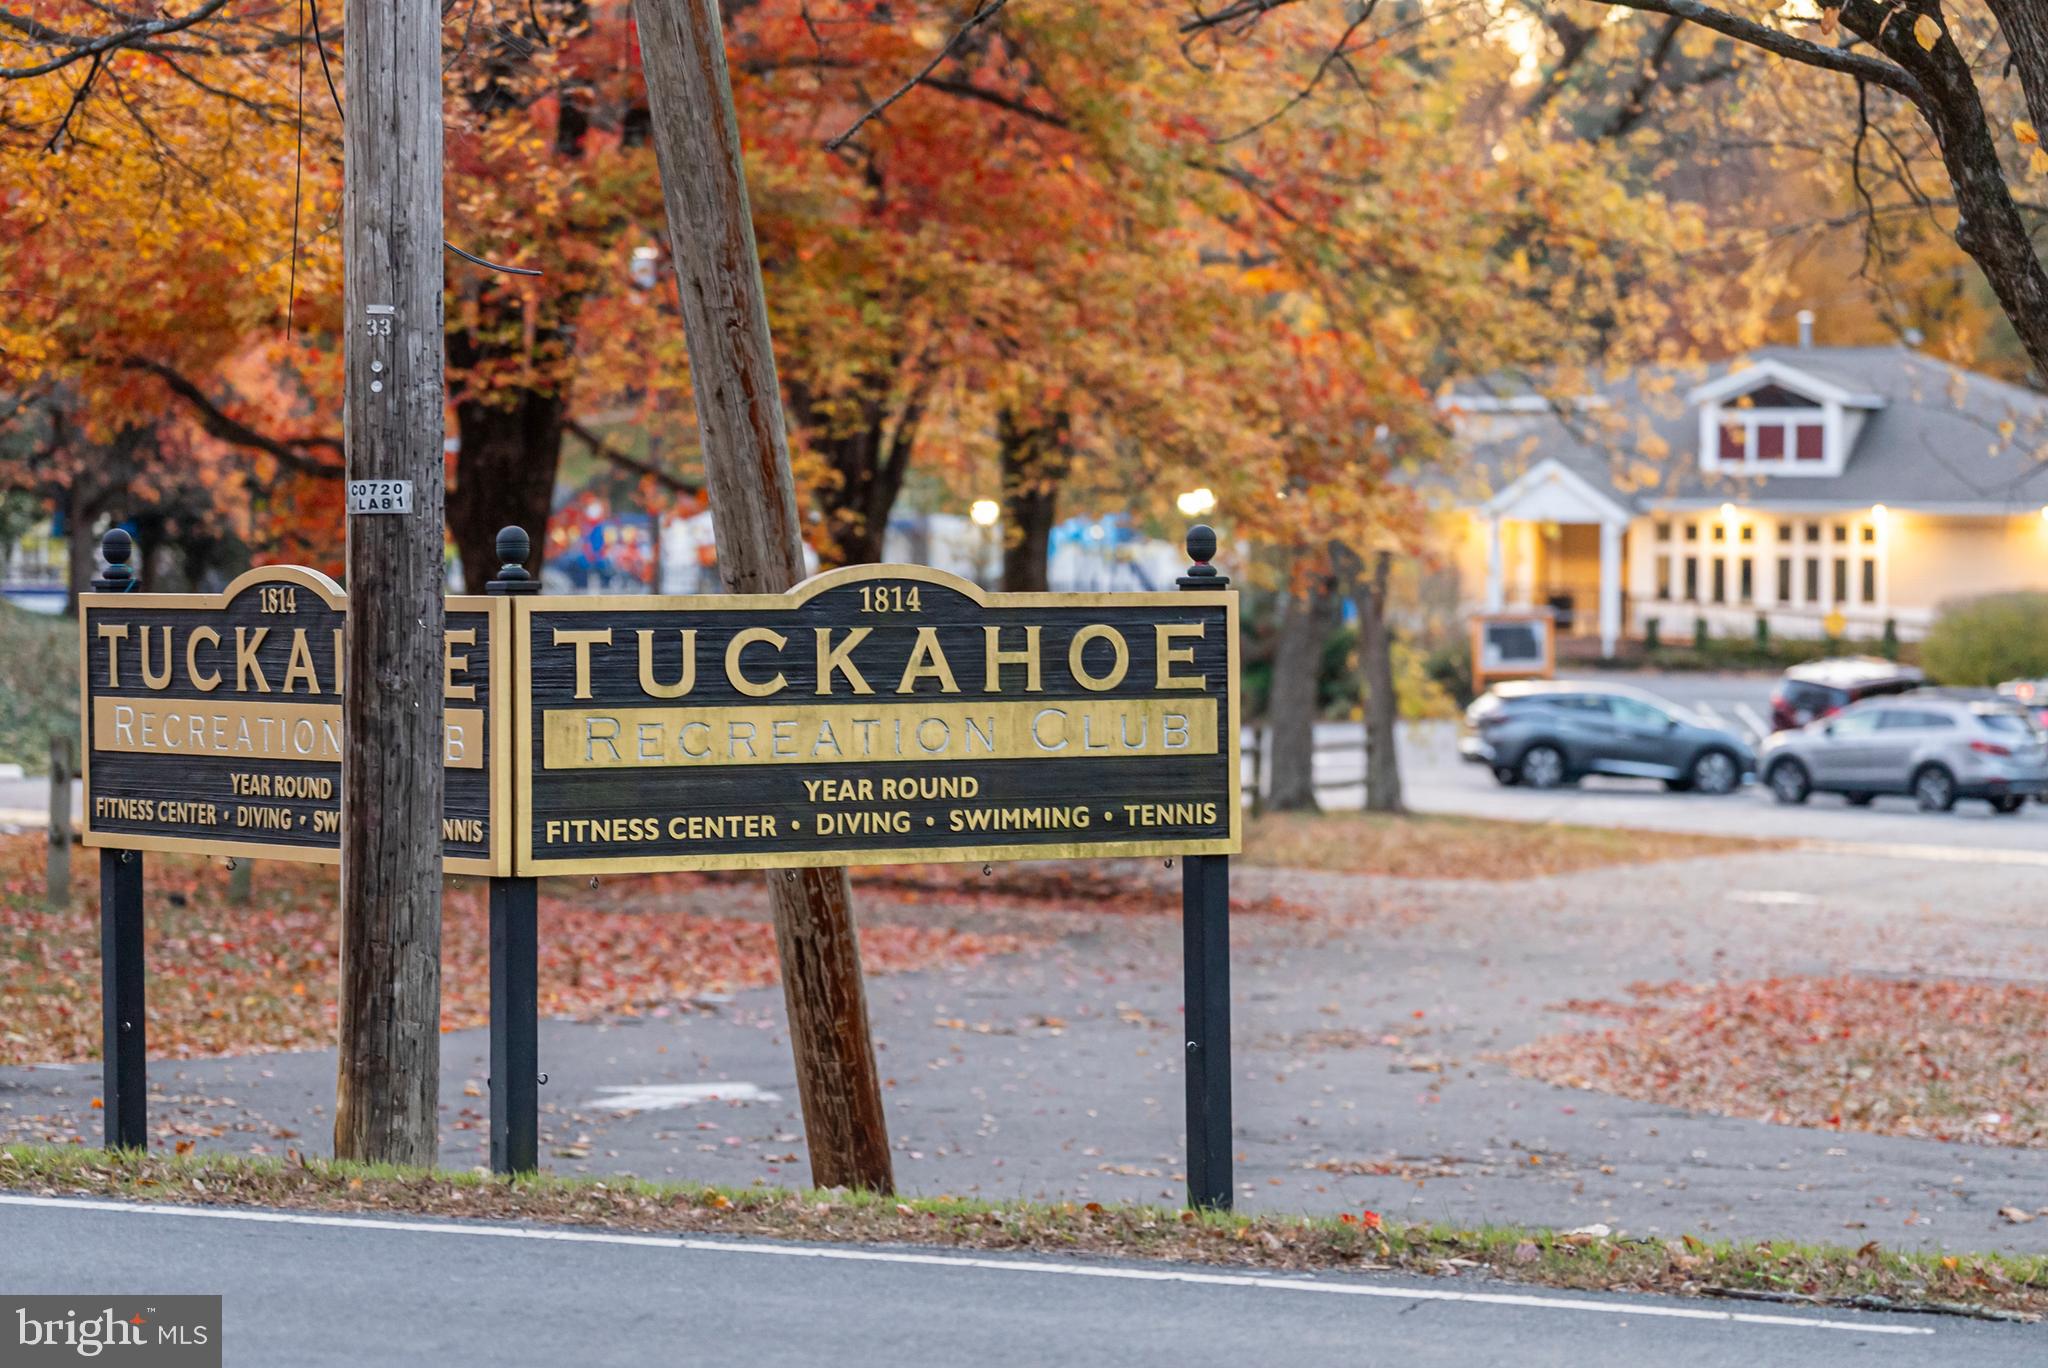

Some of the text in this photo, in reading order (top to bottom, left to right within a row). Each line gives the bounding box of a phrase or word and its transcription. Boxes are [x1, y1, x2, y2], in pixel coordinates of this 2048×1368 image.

[366, 319, 391, 337] 33
[359, 496, 403, 510] LA81
[259, 587, 297, 614] 1814
[859, 586, 921, 613] 1814
[97, 622, 477, 702] TUCKAE
[553, 622, 1207, 699] TUCKAHOE
[231, 773, 332, 800] YEAR ROUND
[803, 776, 979, 802] YEAR ROUND
[96, 797, 154, 821] FITNESS
[157, 801, 217, 826] CENTER
[236, 806, 292, 831] DIVING
[546, 802, 1217, 844] FITNESS CENTER DIVING SWIMMING TENNIS
